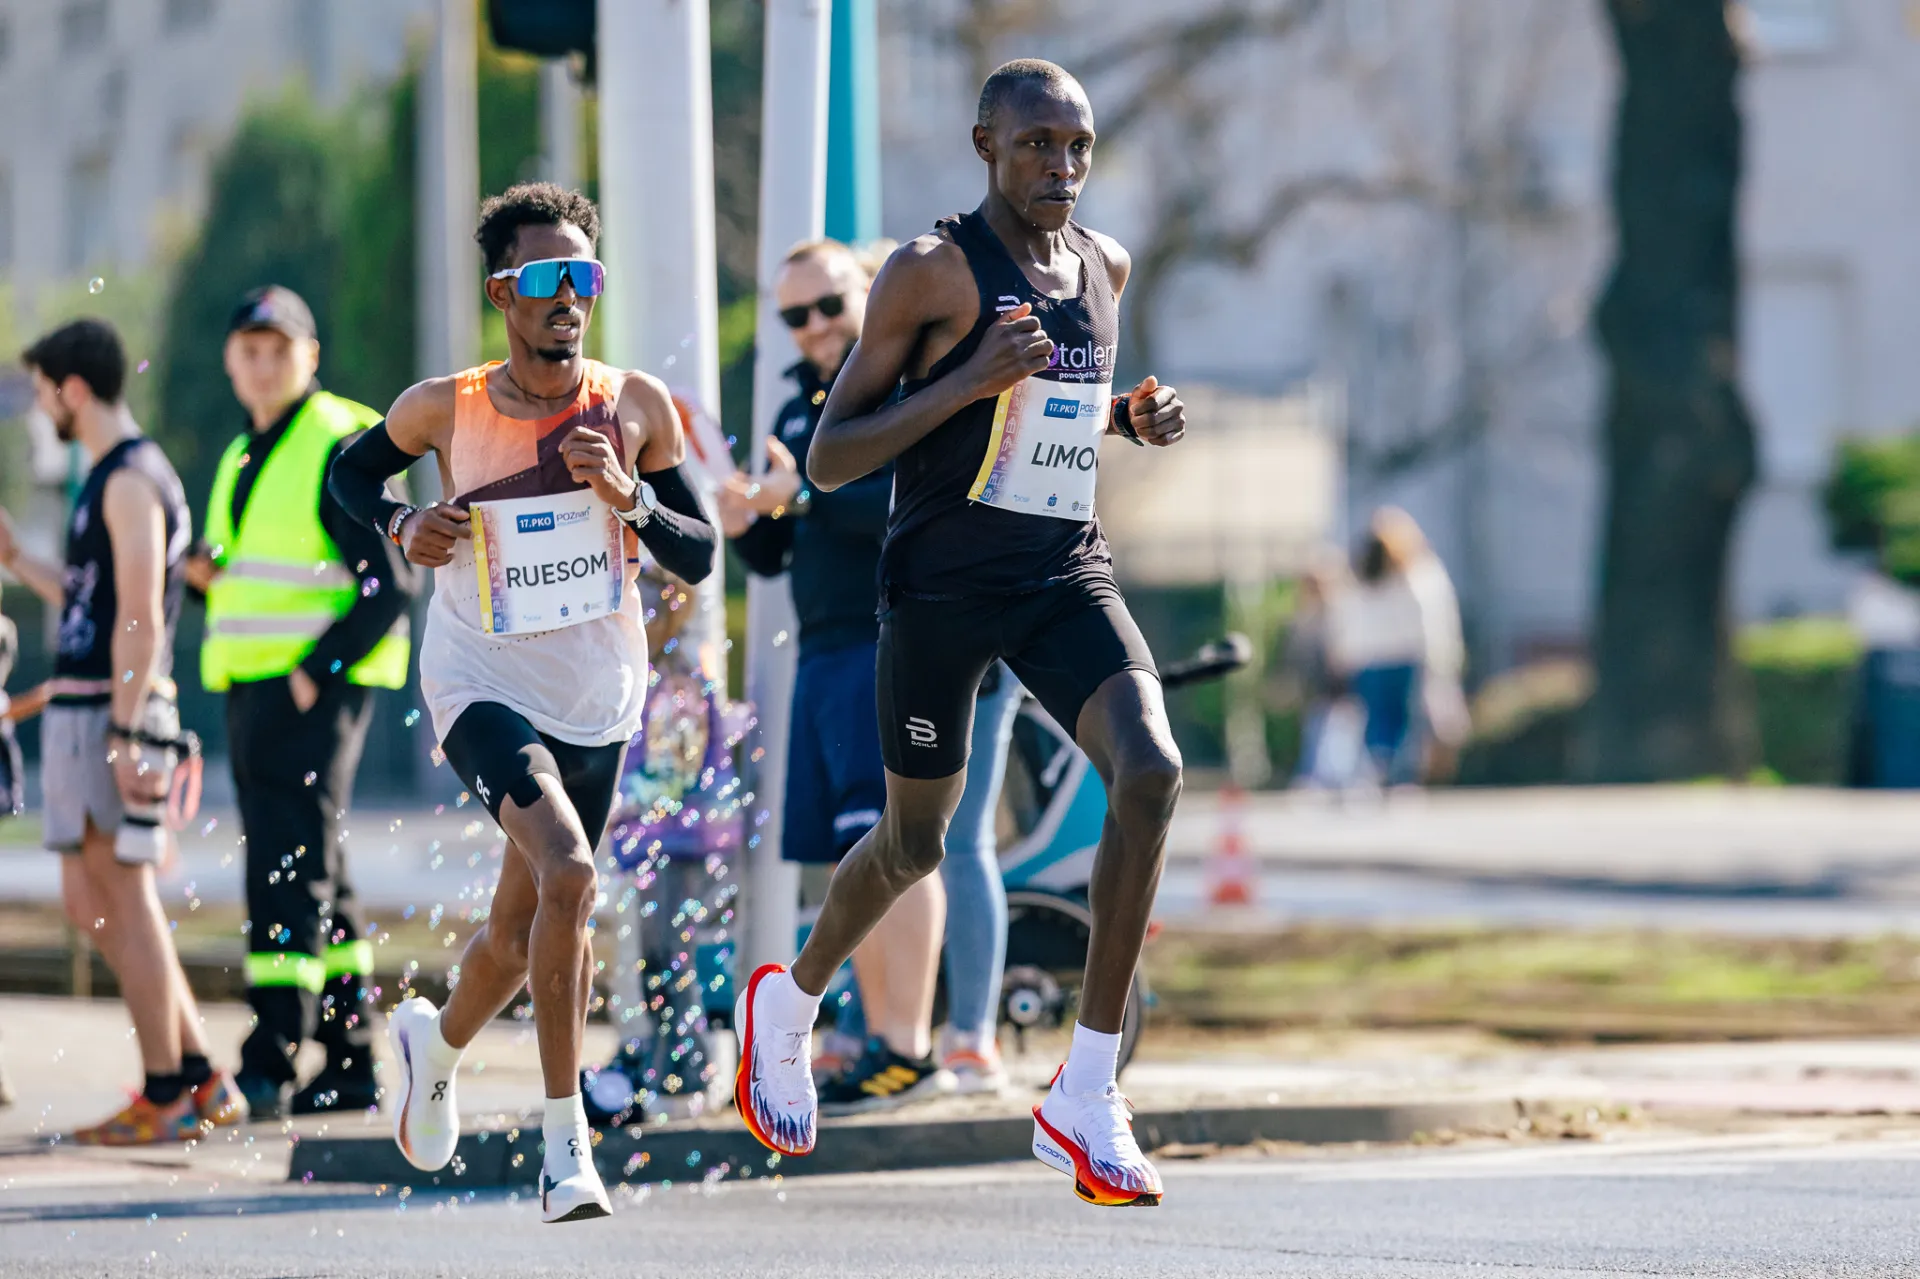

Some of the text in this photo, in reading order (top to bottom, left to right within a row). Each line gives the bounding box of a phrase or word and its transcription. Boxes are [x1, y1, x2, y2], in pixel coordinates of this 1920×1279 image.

[1049, 403, 1077, 414] 17.PKO
[1031, 441, 1095, 471] LIMO
[518, 516, 553, 529] 17.PKO
[505, 551, 608, 588] RUESOM
